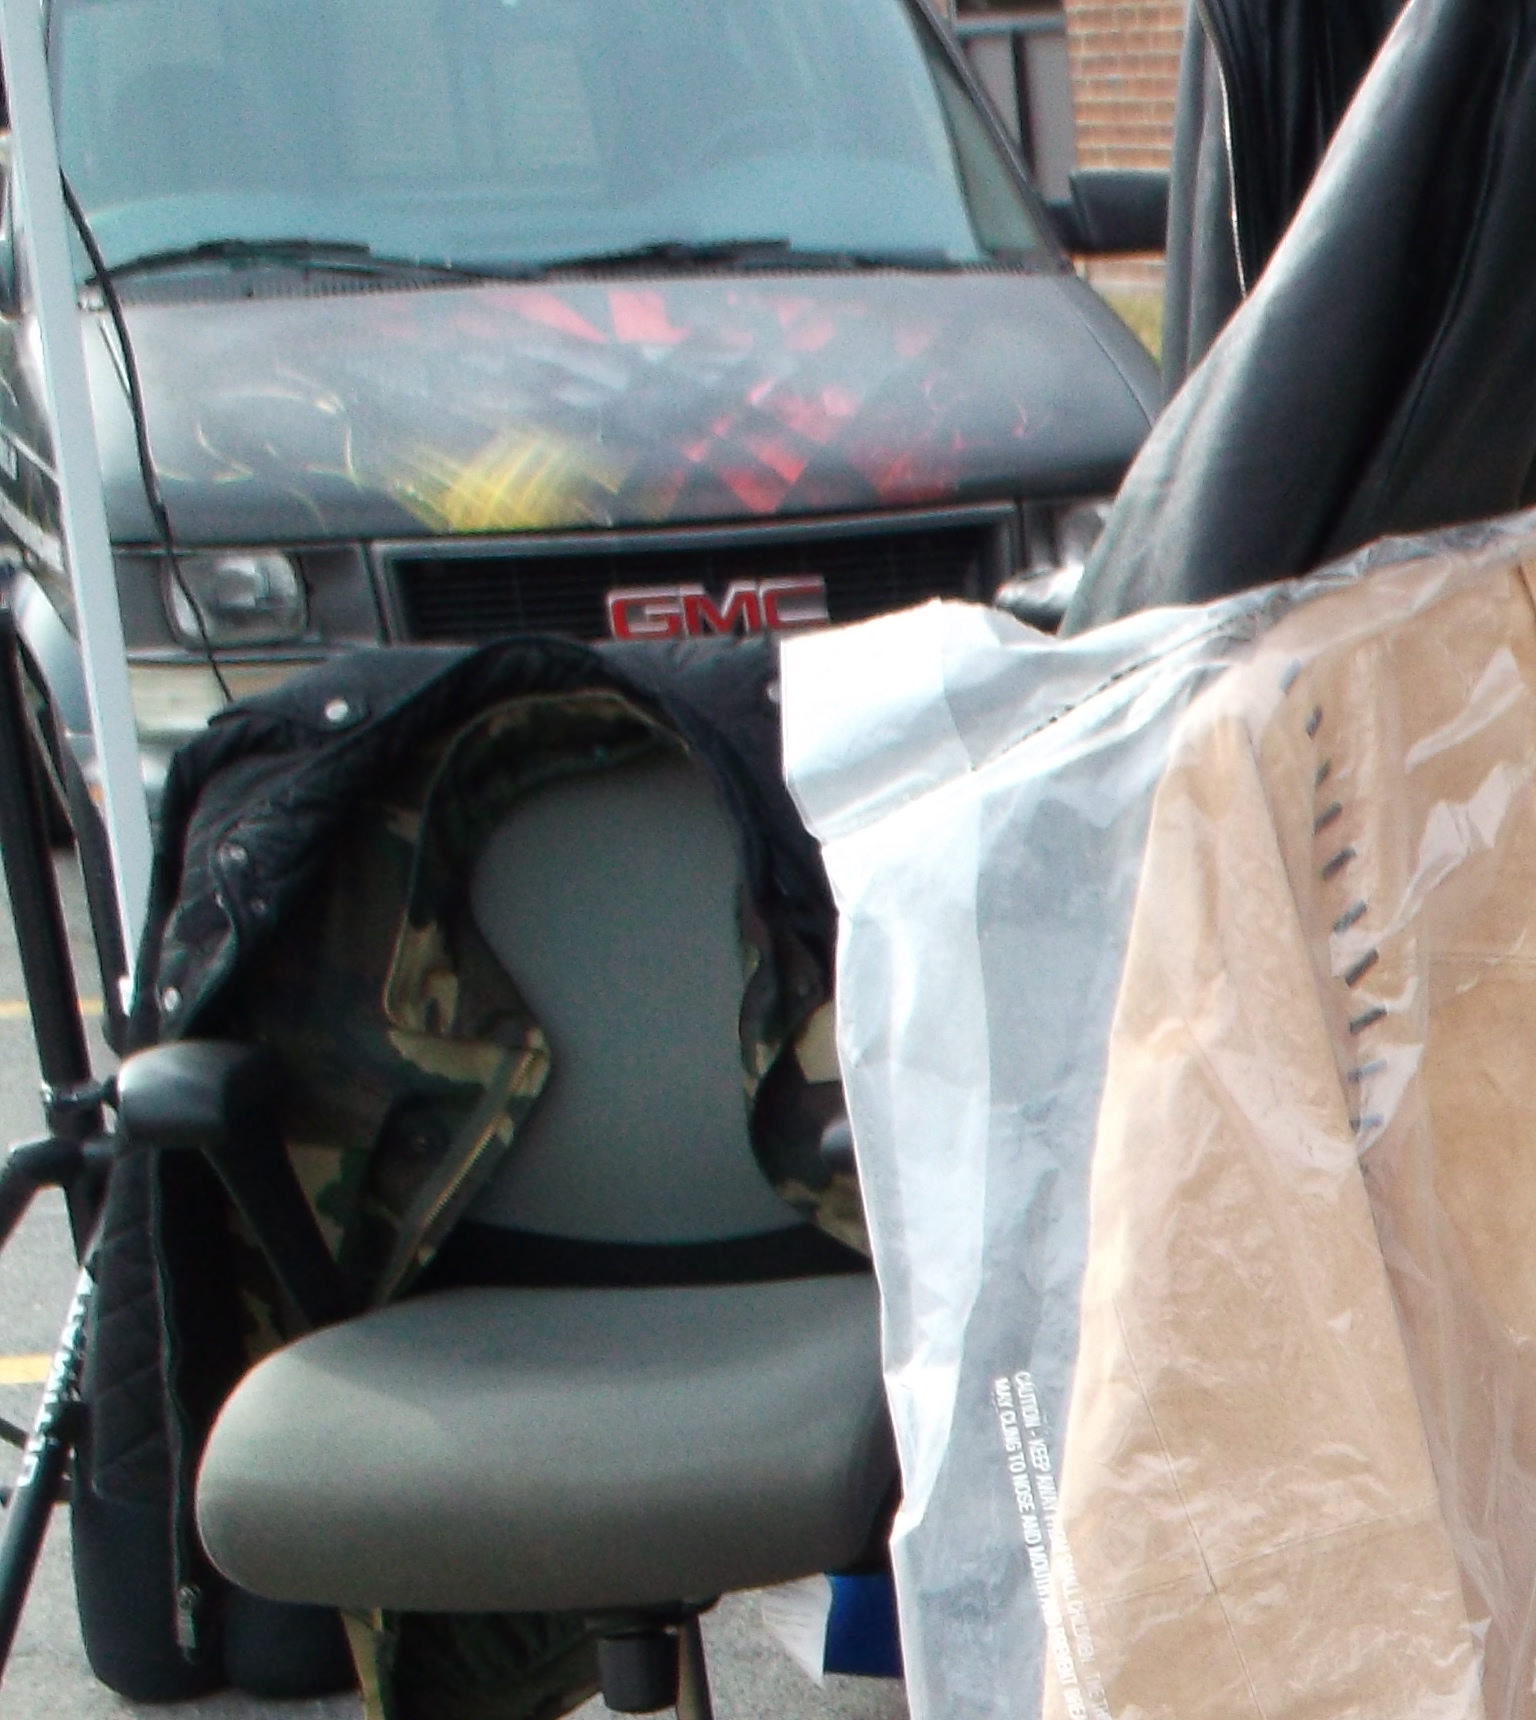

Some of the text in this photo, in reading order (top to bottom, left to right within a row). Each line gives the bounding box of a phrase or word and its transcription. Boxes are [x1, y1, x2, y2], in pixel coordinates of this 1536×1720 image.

[605, 575, 829, 641] GMC
[994, 1377, 1013, 1407] MAY
[1014, 1371, 1041, 1428] CAUTION
[1028, 1439, 1051, 1471] KEEP
[1010, 1453, 1025, 1473] TO
[1012, 1475, 1034, 1512] NOSE
[1021, 1515, 1041, 1544] AND
